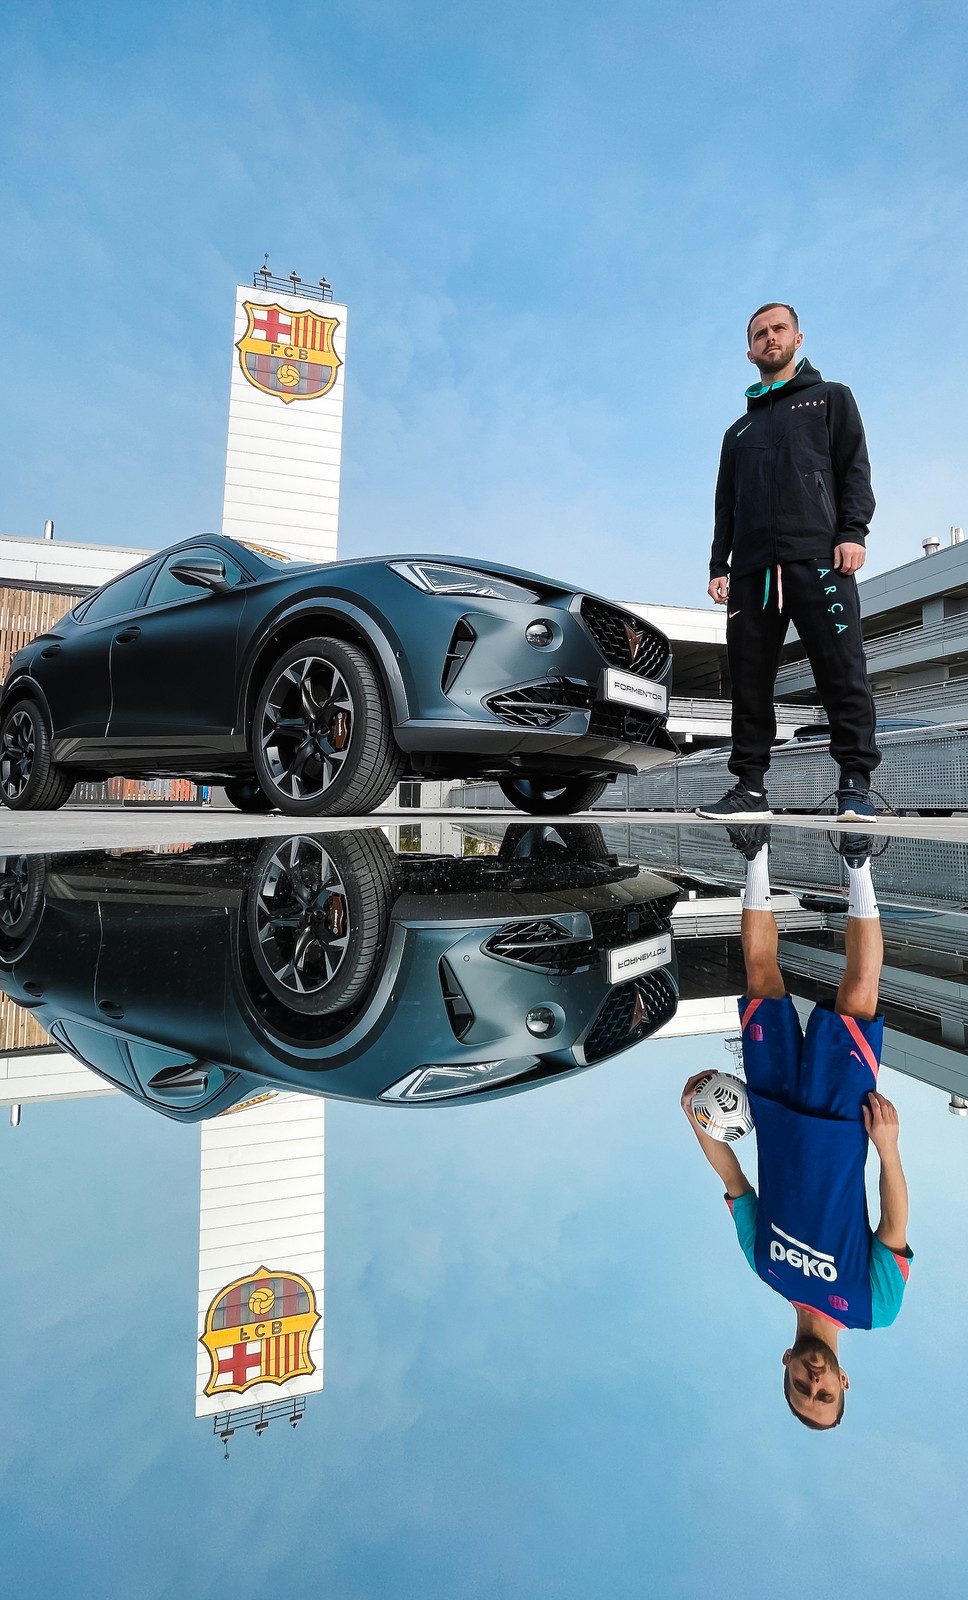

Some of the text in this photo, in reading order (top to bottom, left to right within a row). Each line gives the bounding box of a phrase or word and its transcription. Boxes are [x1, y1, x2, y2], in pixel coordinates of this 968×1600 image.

[271, 344, 308, 360] FCB
[813, 558, 848, 634] ARÇA
[614, 682, 662, 701] FORMENTOR
